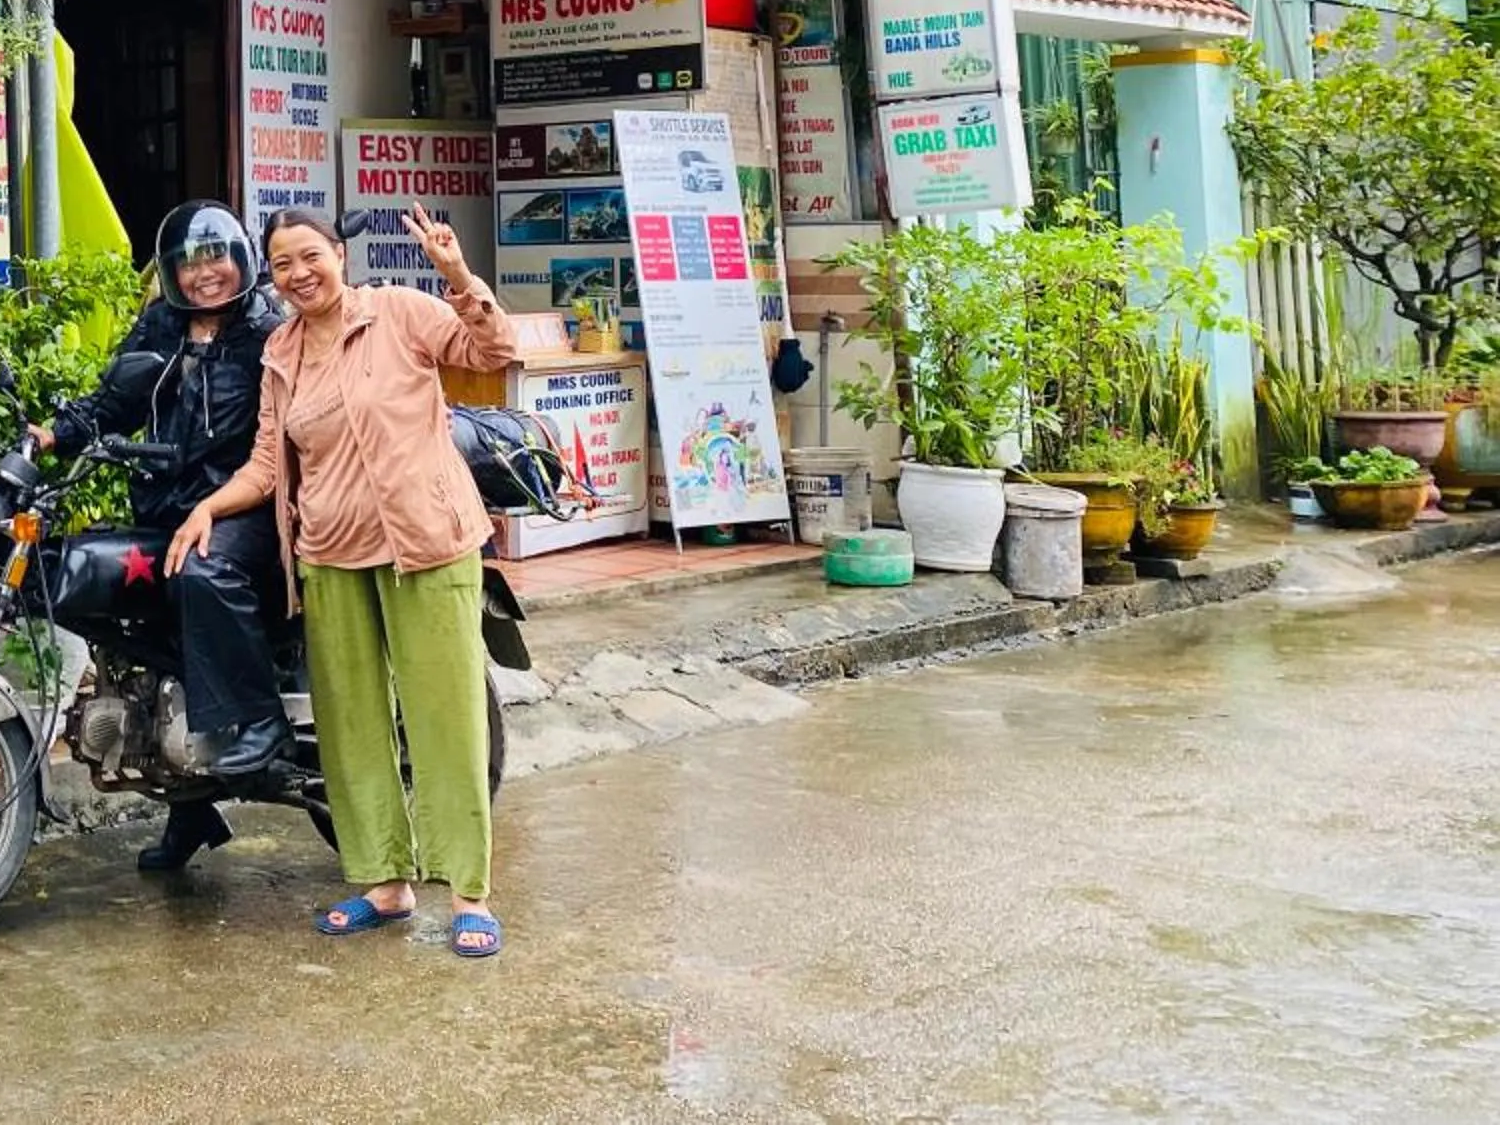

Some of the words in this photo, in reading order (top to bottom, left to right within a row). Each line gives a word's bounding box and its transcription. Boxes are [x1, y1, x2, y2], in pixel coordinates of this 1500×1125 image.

[884, 18, 921, 36] MABLE
[885, 36, 922, 54] BANA
[925, 31, 961, 49] HILLS
[888, 71, 914, 88] HUE
[358, 134, 423, 164] EASY
[432, 135, 492, 164] RIDE
[894, 130, 947, 156] GRAB
[953, 124, 997, 149] TAXI
[357, 169, 492, 197] MOTORBIK
[547, 376, 577, 391] MRS
[580, 371, 622, 388] CUONG
[535, 394, 591, 411] BOOKING
[595, 389, 635, 405] OFFICE
